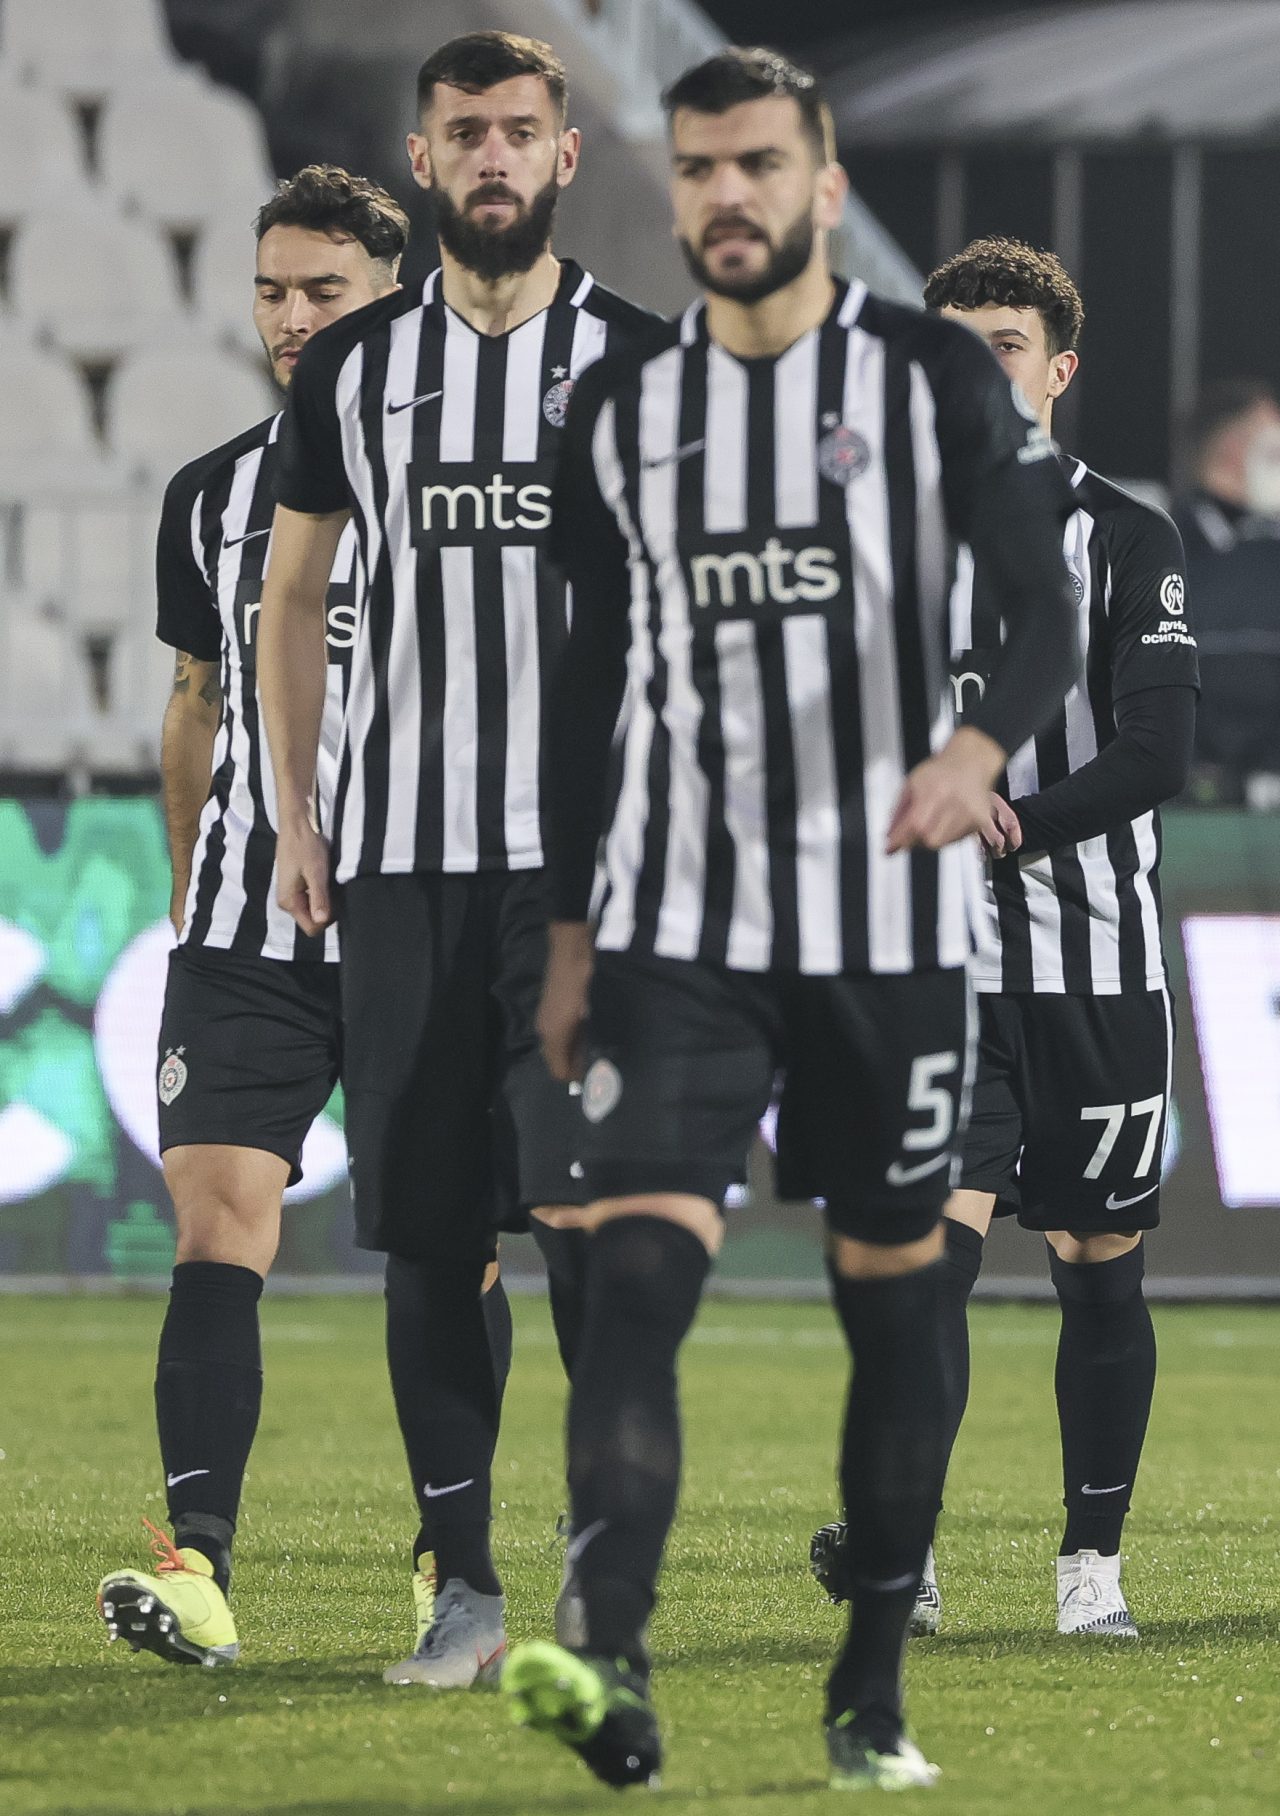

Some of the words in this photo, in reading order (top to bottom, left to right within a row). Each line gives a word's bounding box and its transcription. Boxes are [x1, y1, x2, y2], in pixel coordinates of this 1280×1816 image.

[421, 473, 552, 531] mts
[690, 537, 842, 608] mts
[1158, 620, 1188, 633] ДУН
[902, 1051, 958, 1151] 5
[1080, 1093, 1164, 1180] 77
